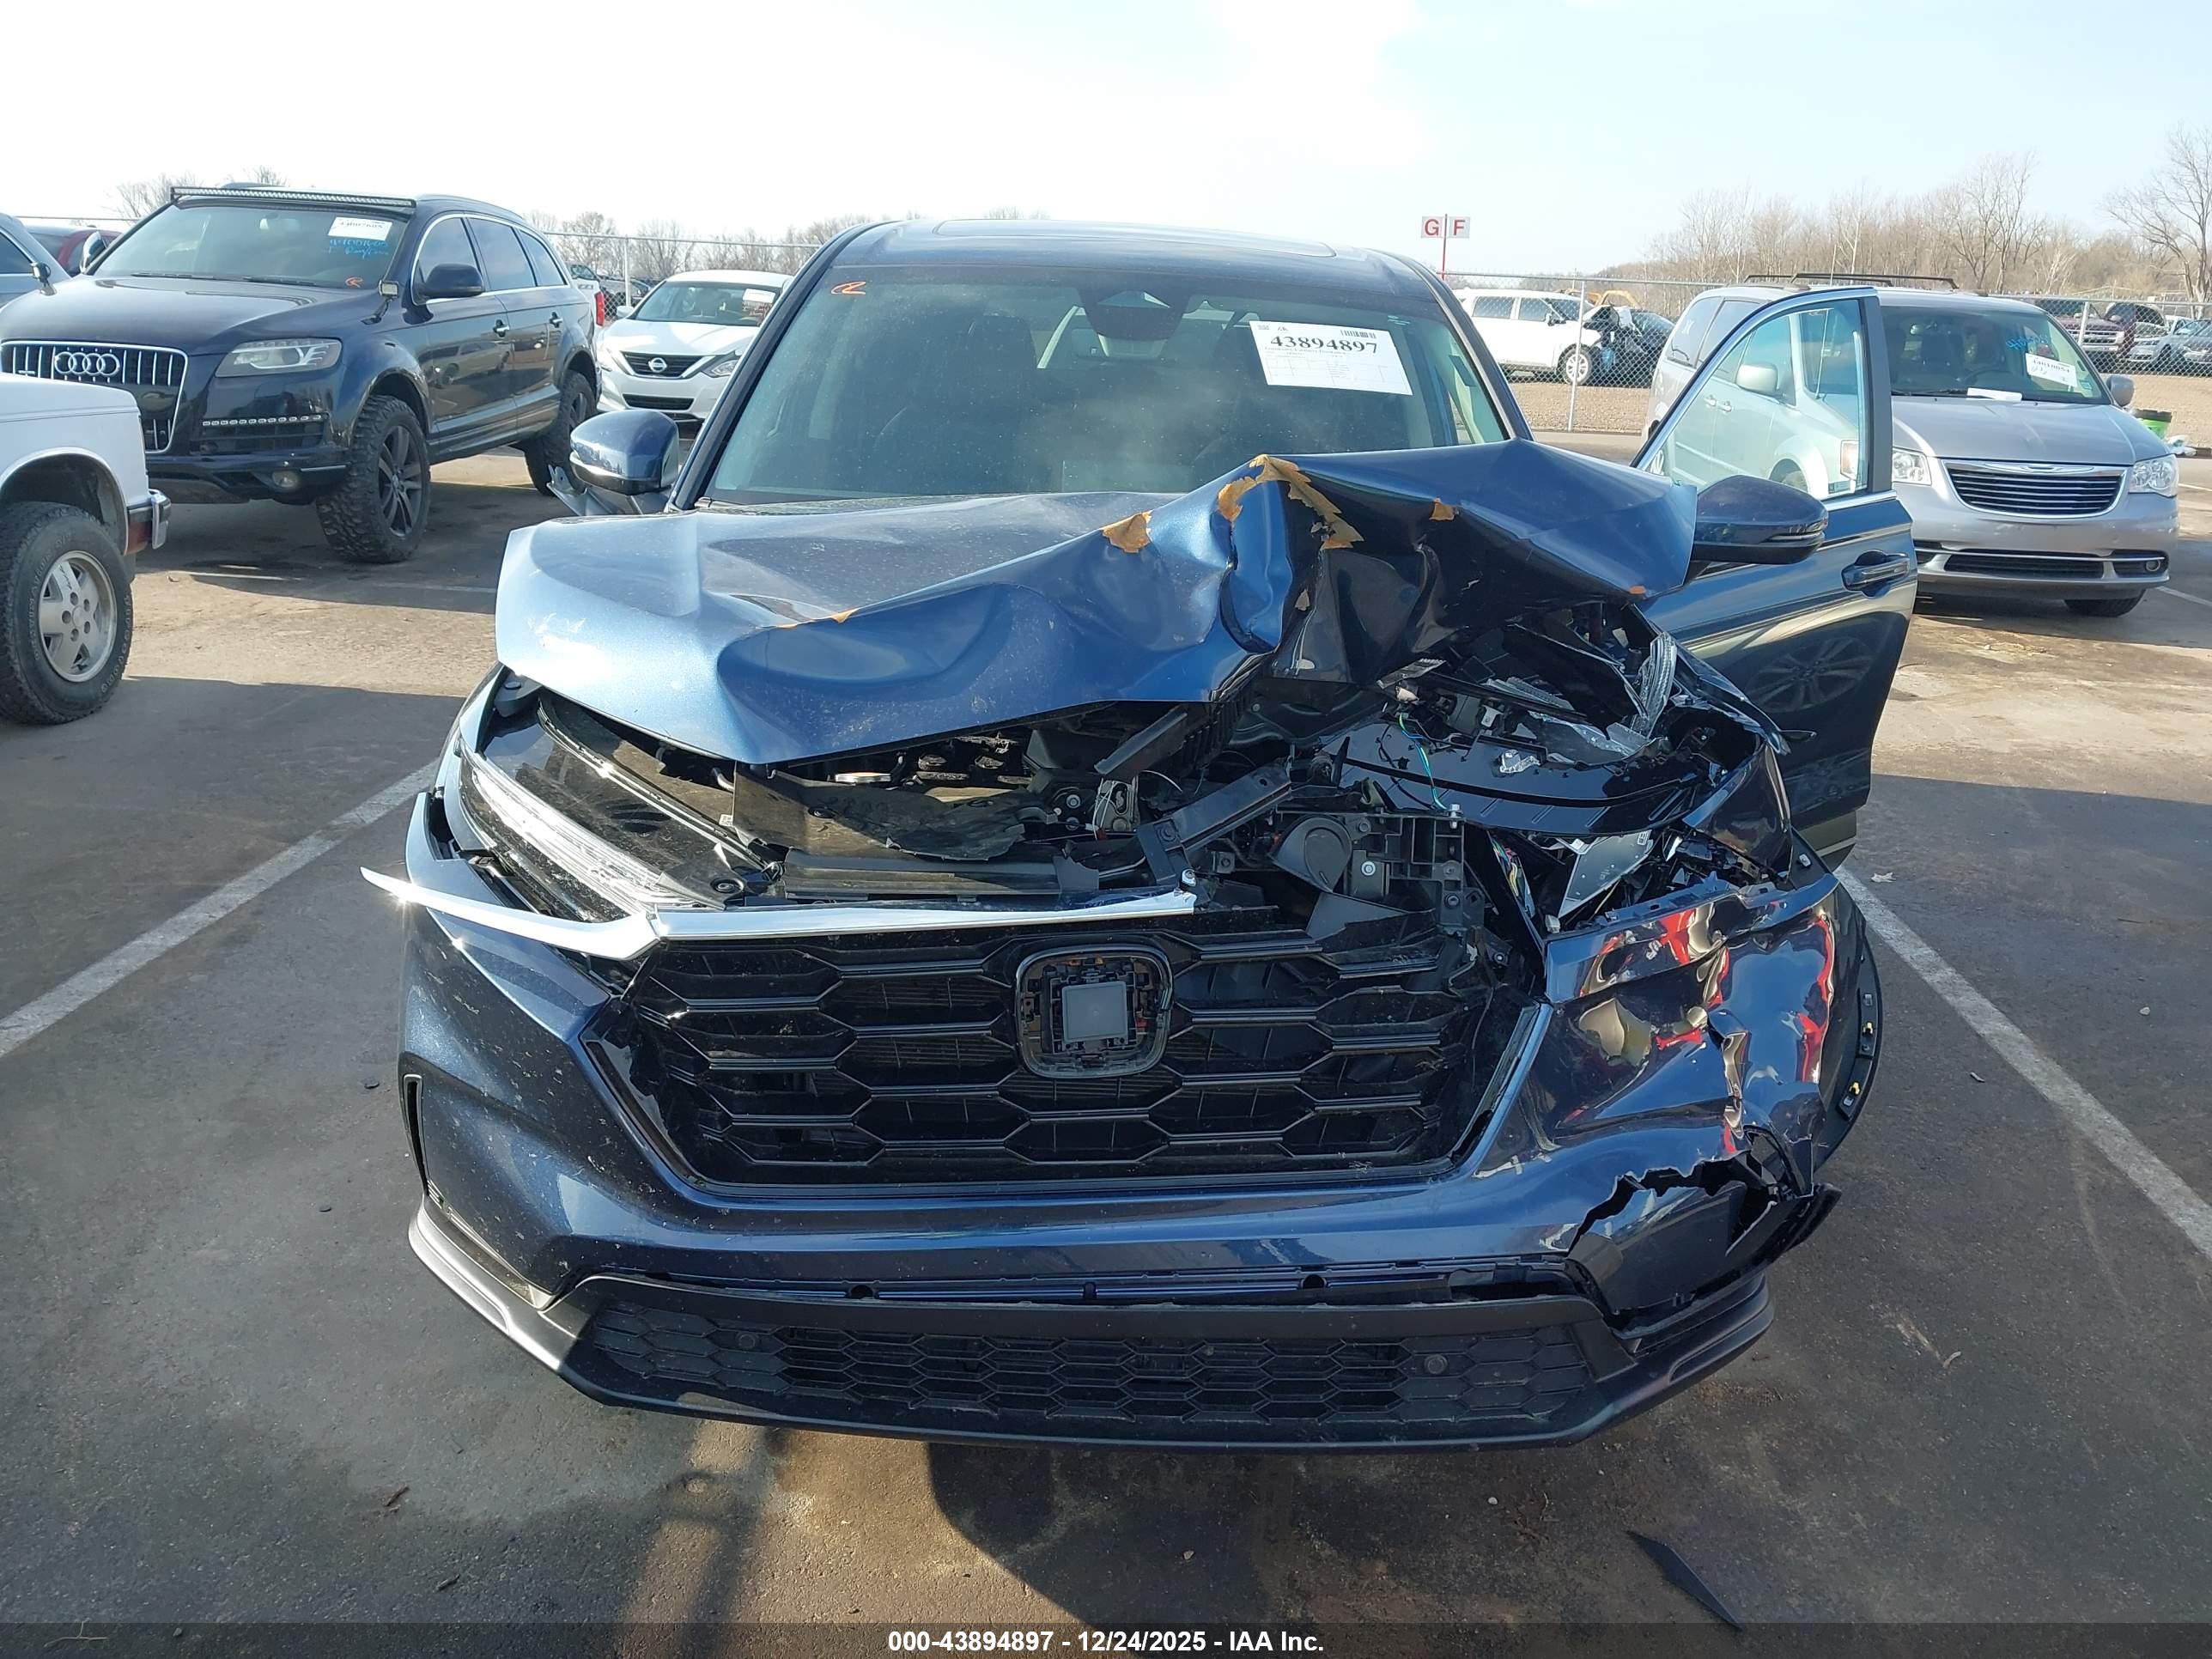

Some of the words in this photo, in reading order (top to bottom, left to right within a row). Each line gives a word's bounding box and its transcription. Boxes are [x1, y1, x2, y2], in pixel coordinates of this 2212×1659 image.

[1424, 219, 1440, 237] G
[1453, 220, 1466, 236] F
[1270, 335, 1377, 354] 43894897
